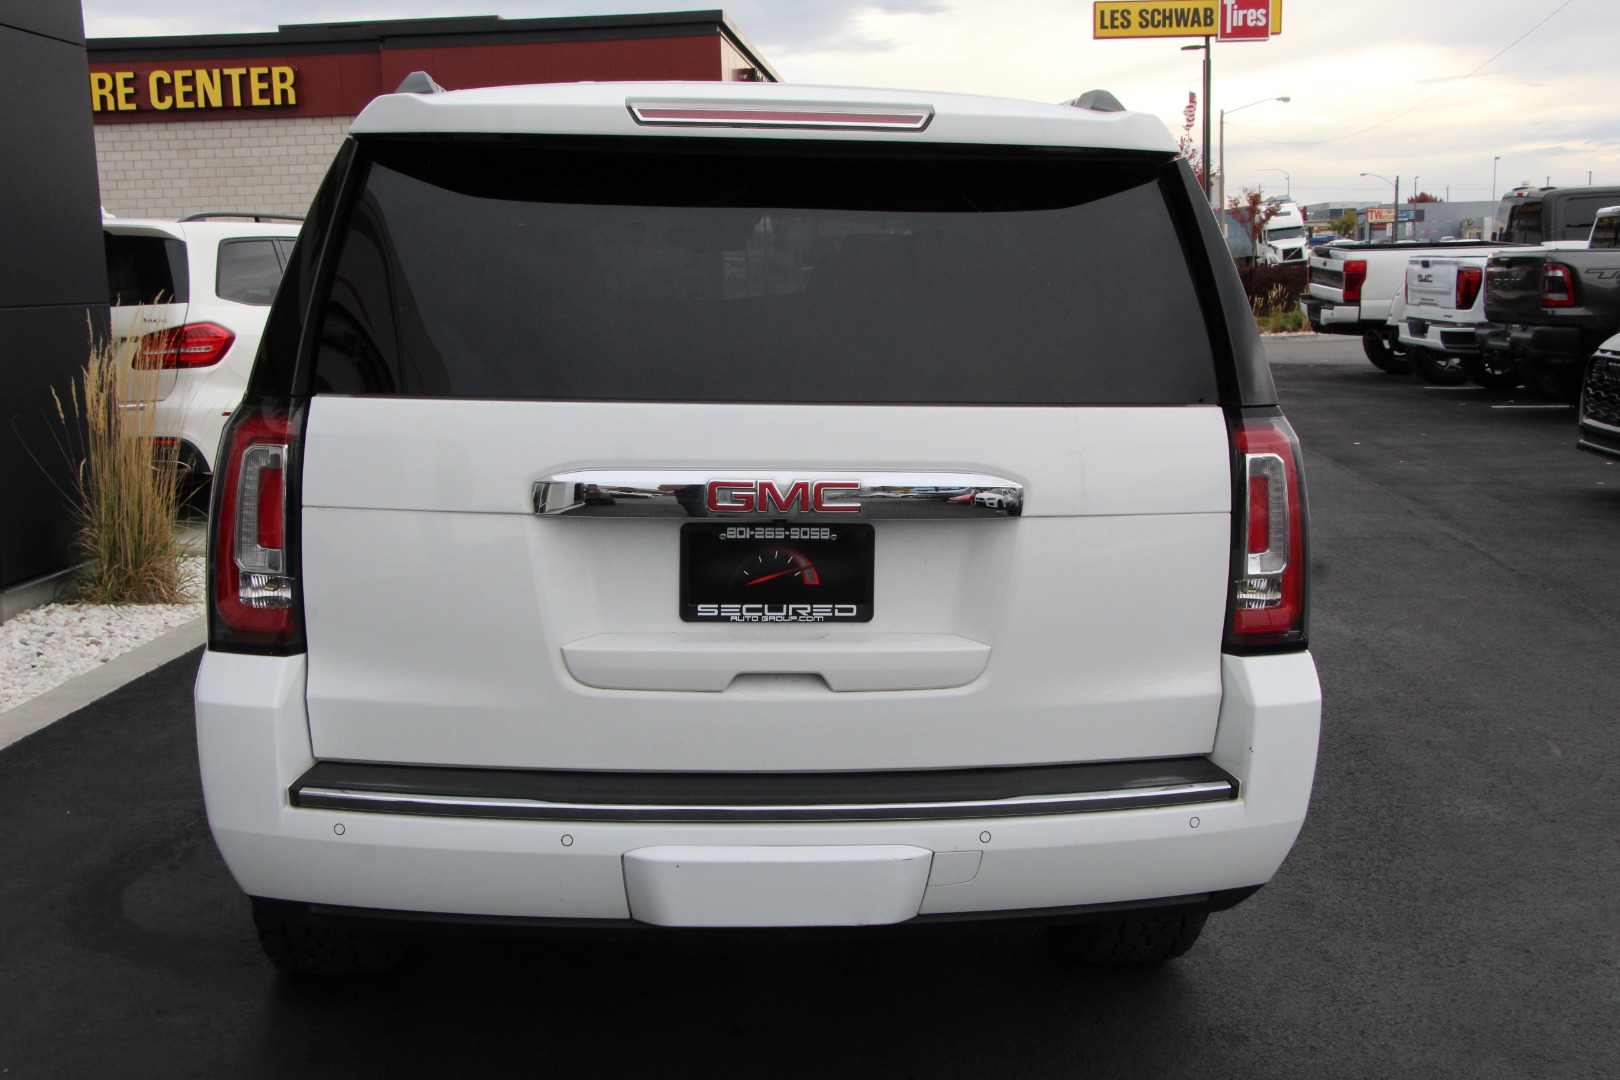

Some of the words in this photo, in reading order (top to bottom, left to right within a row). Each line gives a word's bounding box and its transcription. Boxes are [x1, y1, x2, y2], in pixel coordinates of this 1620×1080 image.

[1100, 9, 1131, 29] LES
[1138, 7, 1214, 29] SCHWAB
[1223, 0, 1267, 33] Tires
[149, 66, 297, 110] CENTER
[706, 480, 861, 512] GMC
[726, 527, 831, 539] 801-265-9058
[697, 604, 857, 616] SECURED
